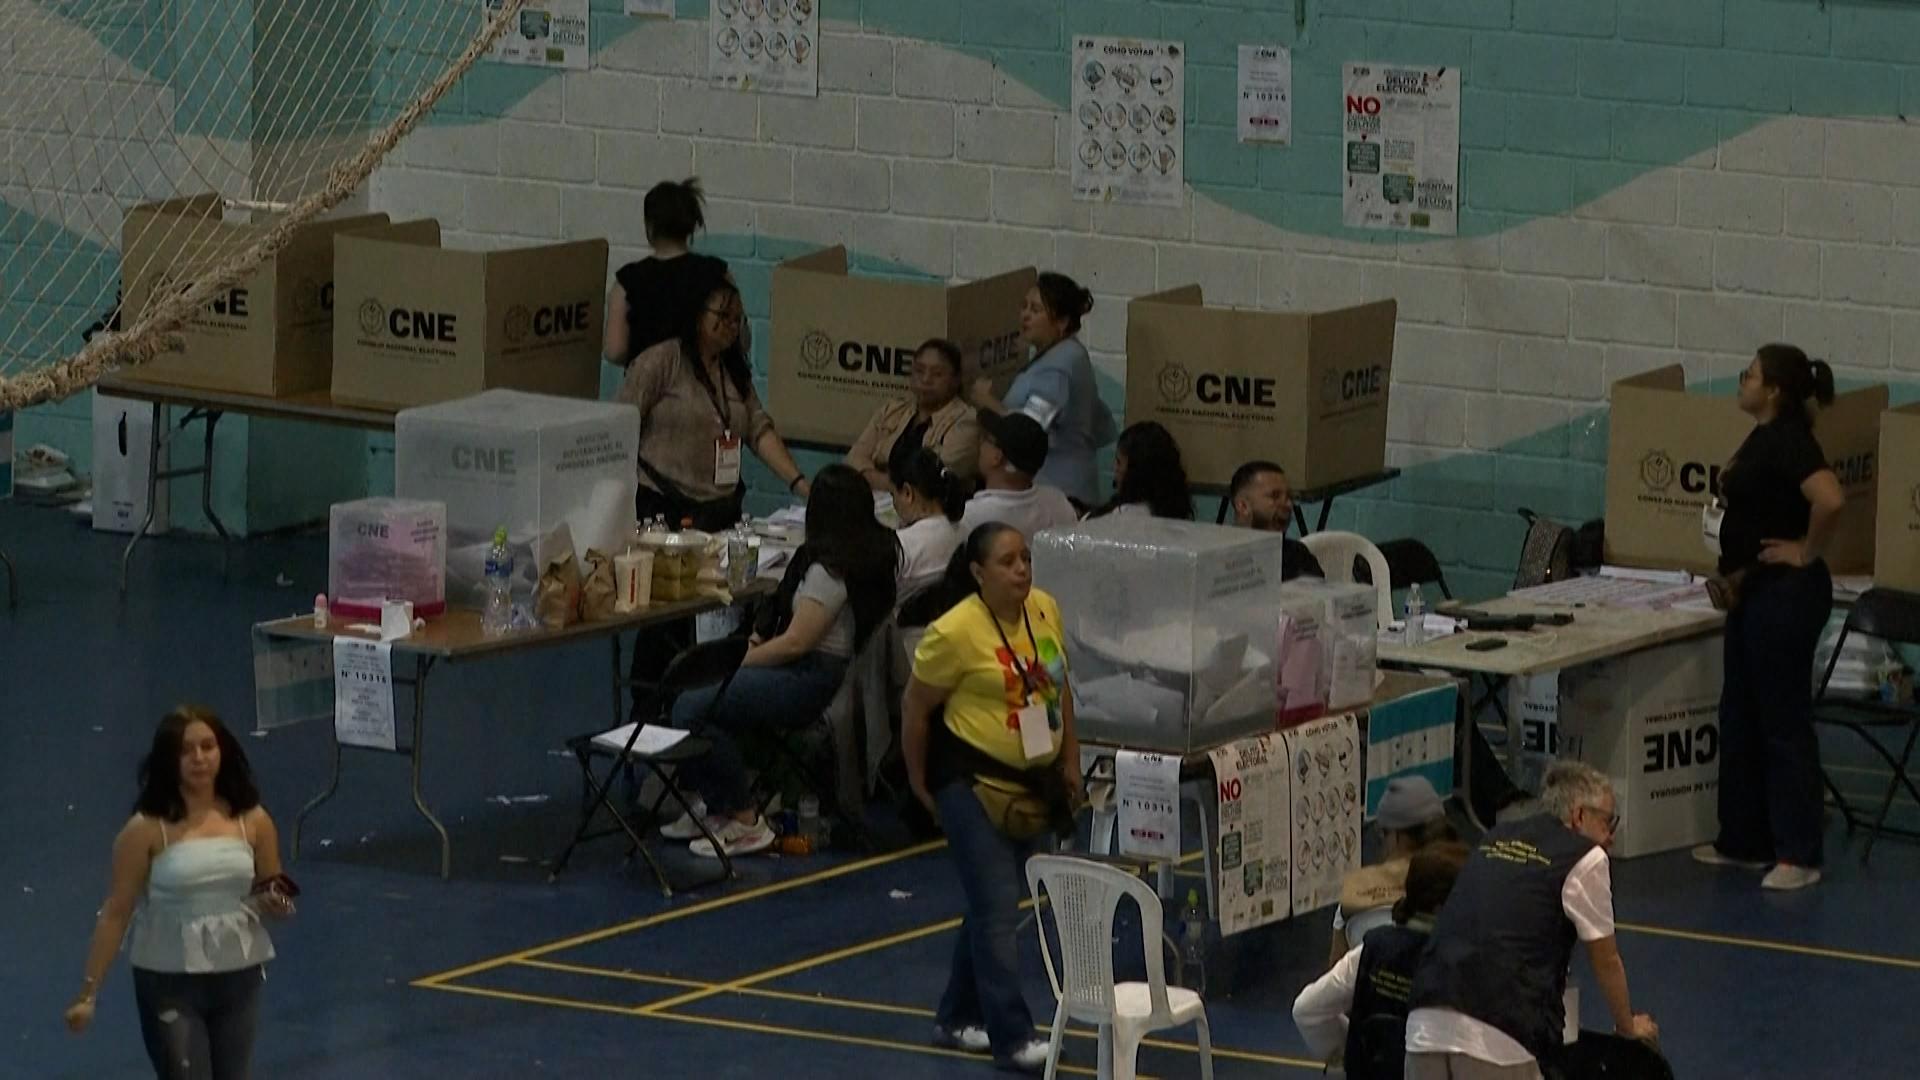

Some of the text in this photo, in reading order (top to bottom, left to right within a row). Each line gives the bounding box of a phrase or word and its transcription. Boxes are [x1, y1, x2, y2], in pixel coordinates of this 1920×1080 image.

[1376, 84, 1428, 95] ELECTORAL
[1347, 95, 1381, 115] NO
[389, 308, 457, 343] CNE
[533, 301, 591, 337] CNE
[838, 340, 914, 376] CNE
[978, 331, 1020, 369] CNE
[797, 371, 832, 381] CONSEJO
[832, 376, 869, 386] NACIONAL
[1196, 373, 1276, 407] CNE
[1341, 365, 1383, 401] CNE
[1155, 405, 1275, 422] CONSEJO NACIONAL ELECTORAL
[451, 446, 517, 475] CNE
[1637, 495, 1673, 506] CONSEJO
[357, 522, 390, 539] CNE
[1643, 723, 1719, 774] CNE
[1220, 778, 1242, 803] NO
[1650, 784, 1693, 801] HONDURAS
